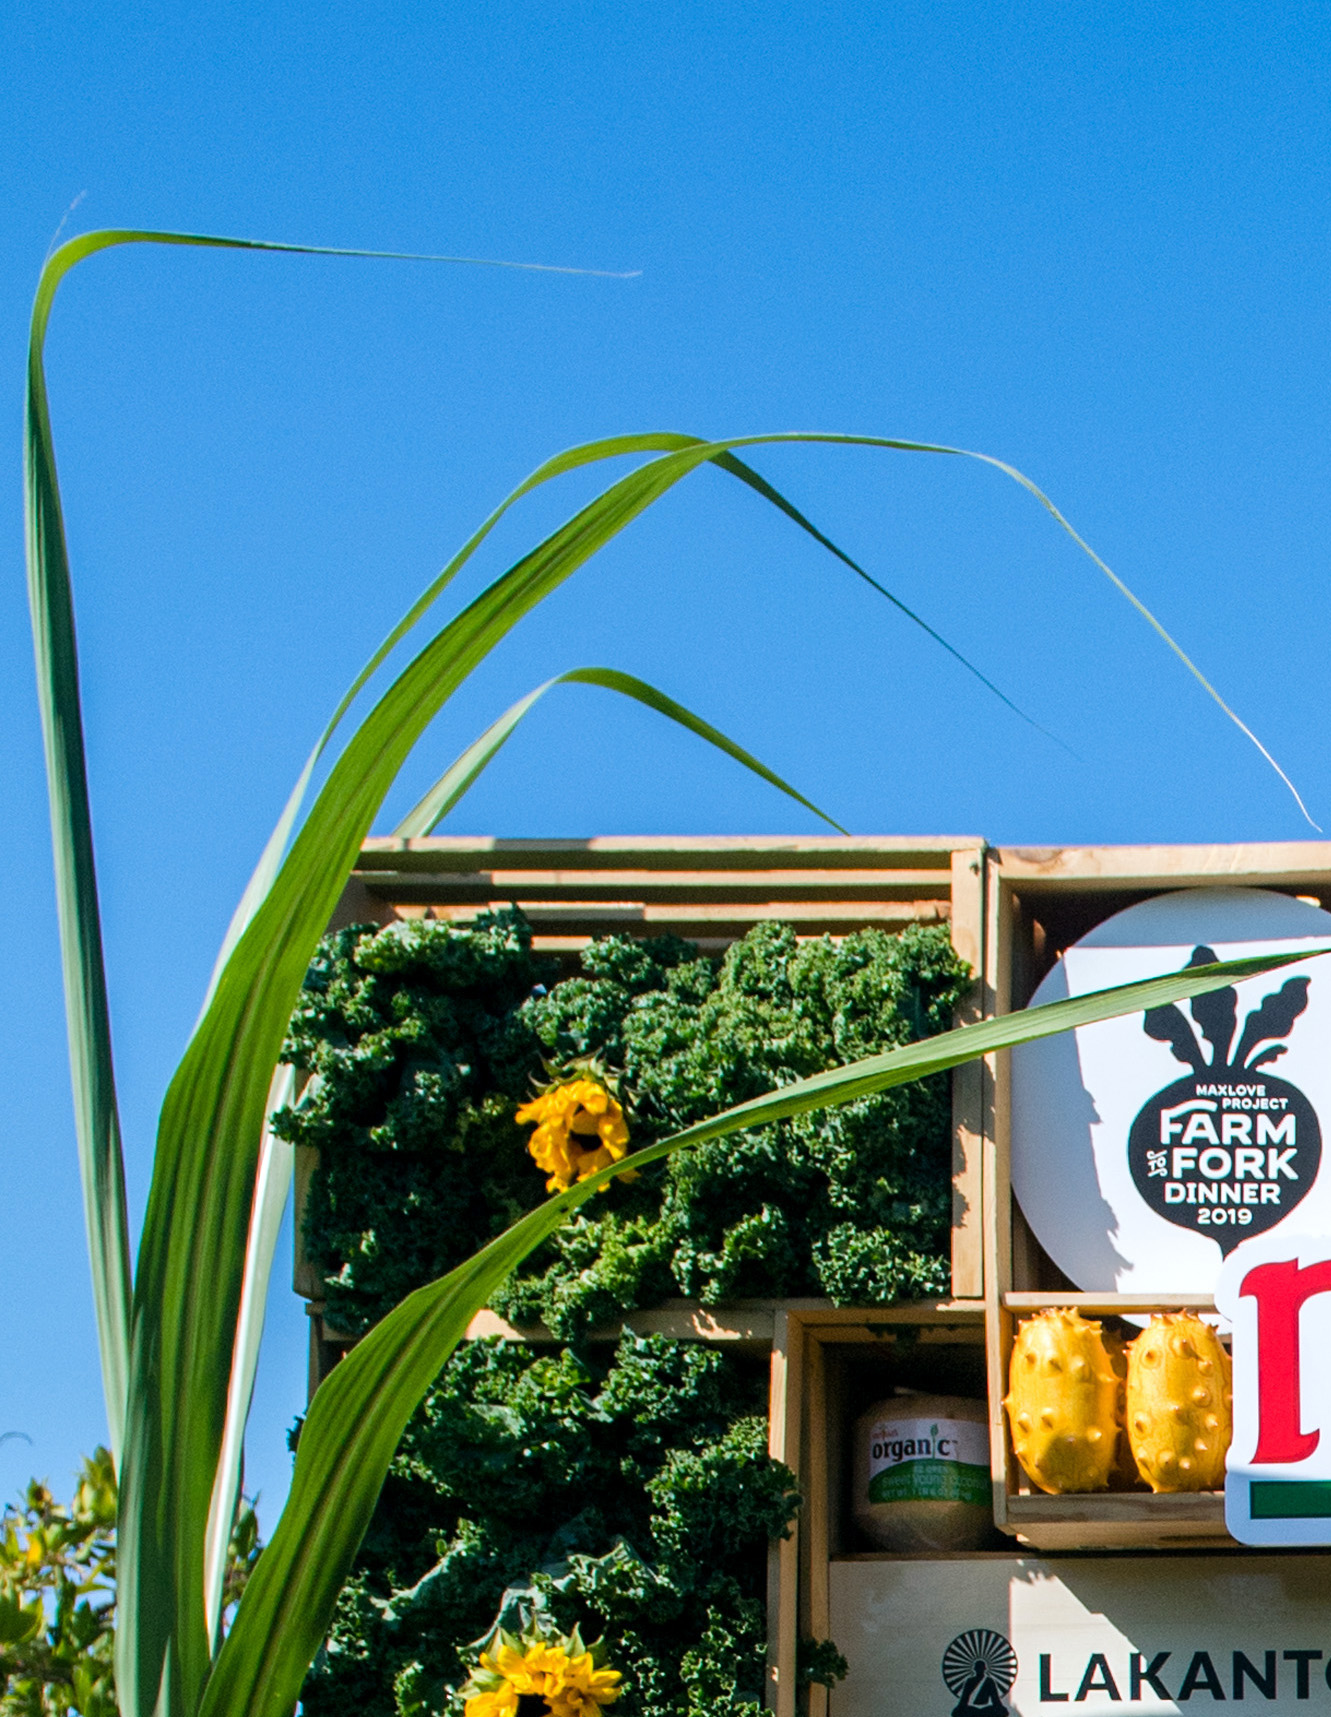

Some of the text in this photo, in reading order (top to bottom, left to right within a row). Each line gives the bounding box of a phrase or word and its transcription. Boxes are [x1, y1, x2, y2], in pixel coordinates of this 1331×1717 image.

[1196, 1084, 1266, 1097] MAXLOVE
[1222, 1098, 1289, 1110] PROJECT
[1160, 1099, 1296, 1146] FARM
[1172, 1147, 1299, 1180] FORK
[1164, 1182, 1281, 1204] DINNER
[1197, 1208, 1253, 1225] 2019
